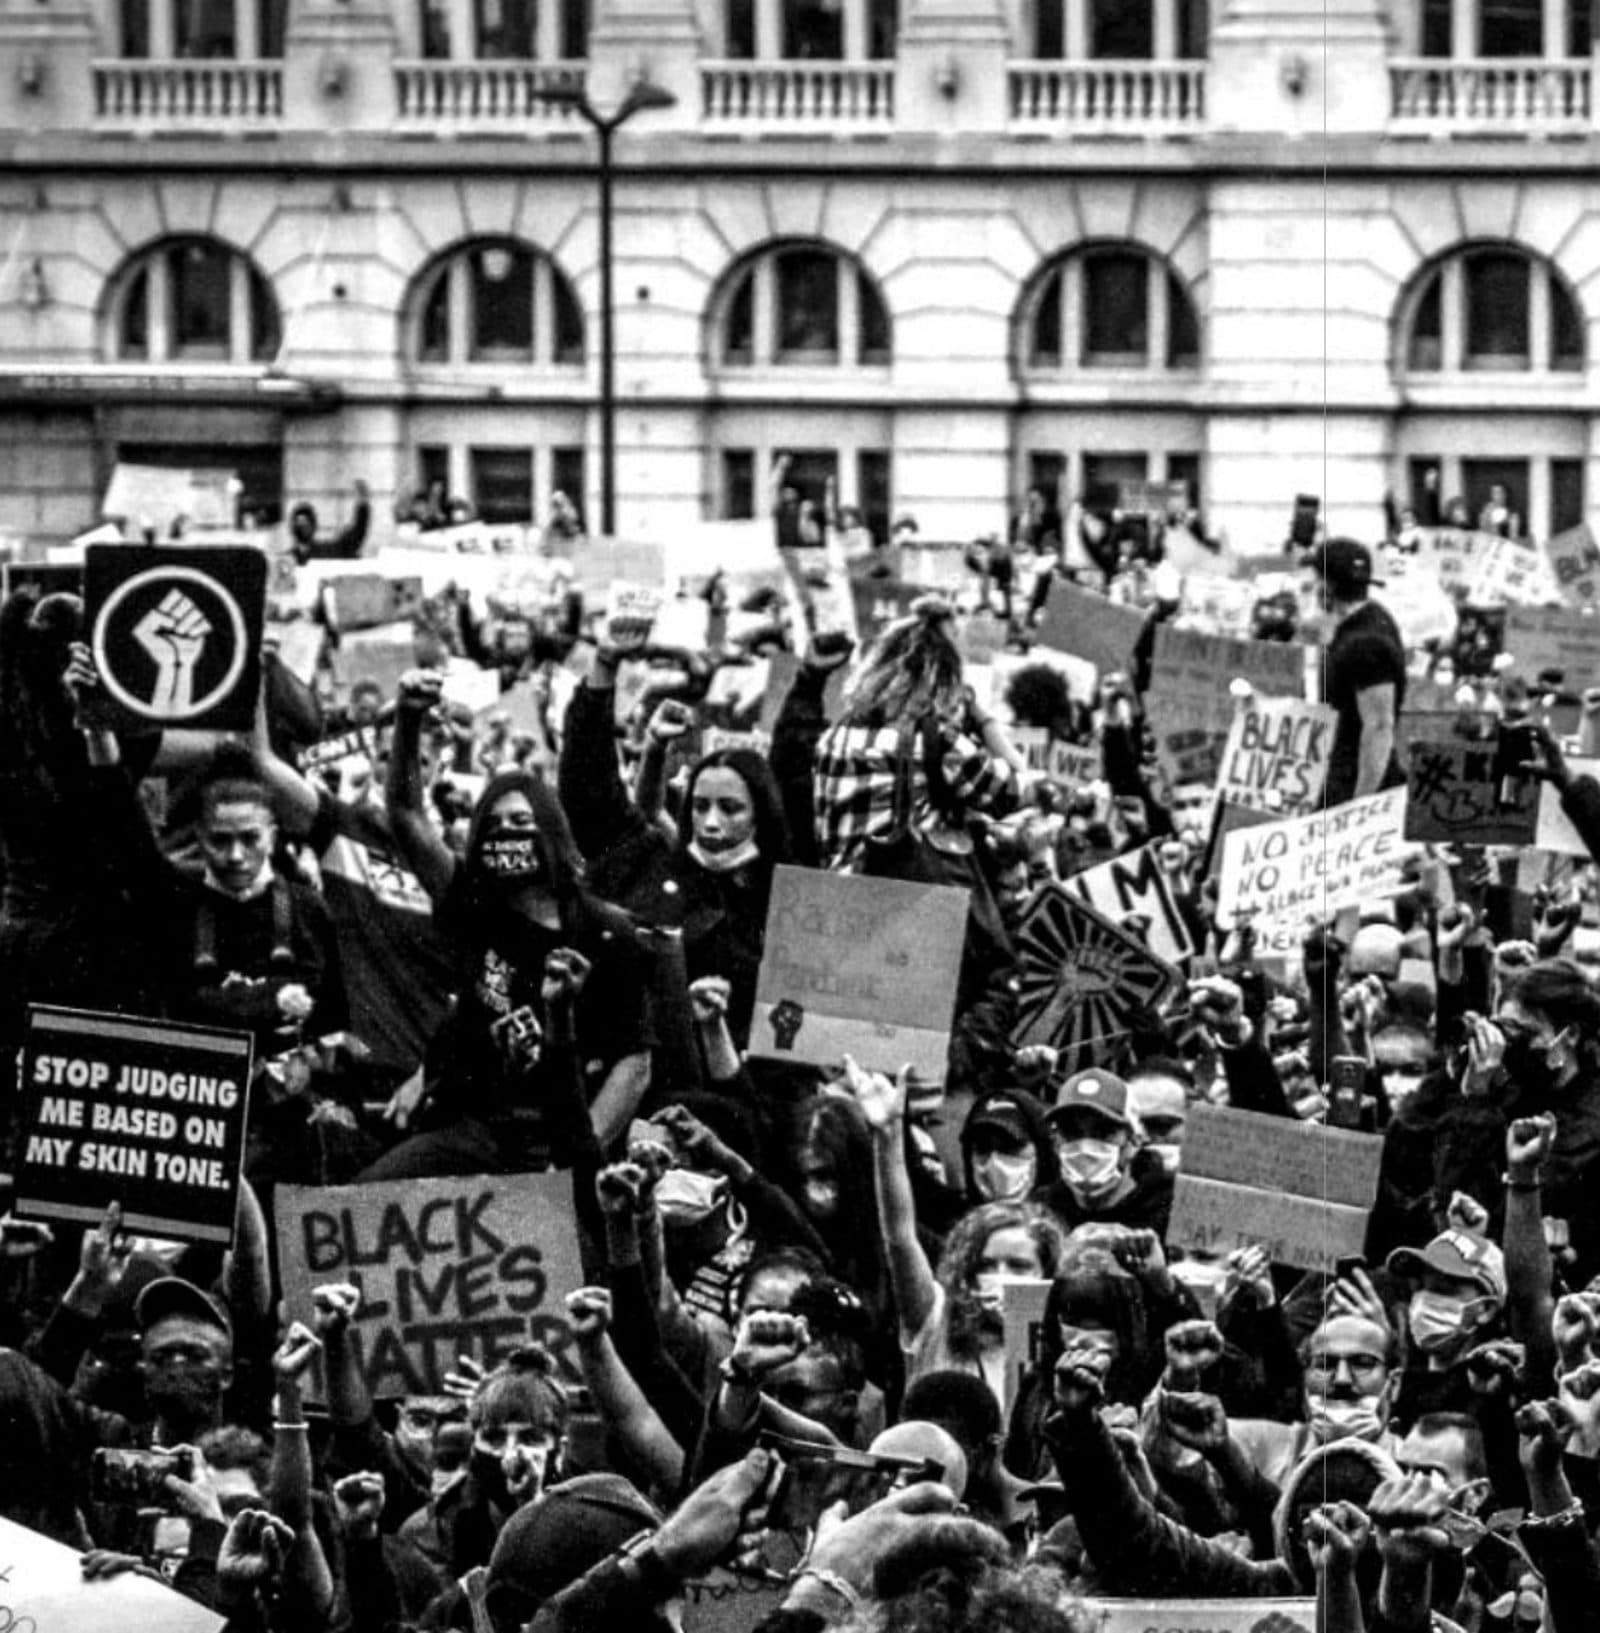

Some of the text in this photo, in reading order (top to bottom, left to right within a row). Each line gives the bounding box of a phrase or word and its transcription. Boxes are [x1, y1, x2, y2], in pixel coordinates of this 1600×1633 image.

[1241, 711, 1328, 764] BLACK
[1228, 749, 1312, 800] LIVES
[1242, 830, 1288, 866] NO
[1299, 796, 1394, 846] JUSTICE
[1237, 866, 1280, 896] NO
[1300, 828, 1399, 880] PEACE
[33, 1055, 238, 1108] STOP JUDGING
[38, 1096, 226, 1148] ME BASED ON
[25, 1134, 230, 1189] MY SKIN TONE.
[302, 1192, 505, 1273] BLACK
[349, 1246, 548, 1321] LIVES
